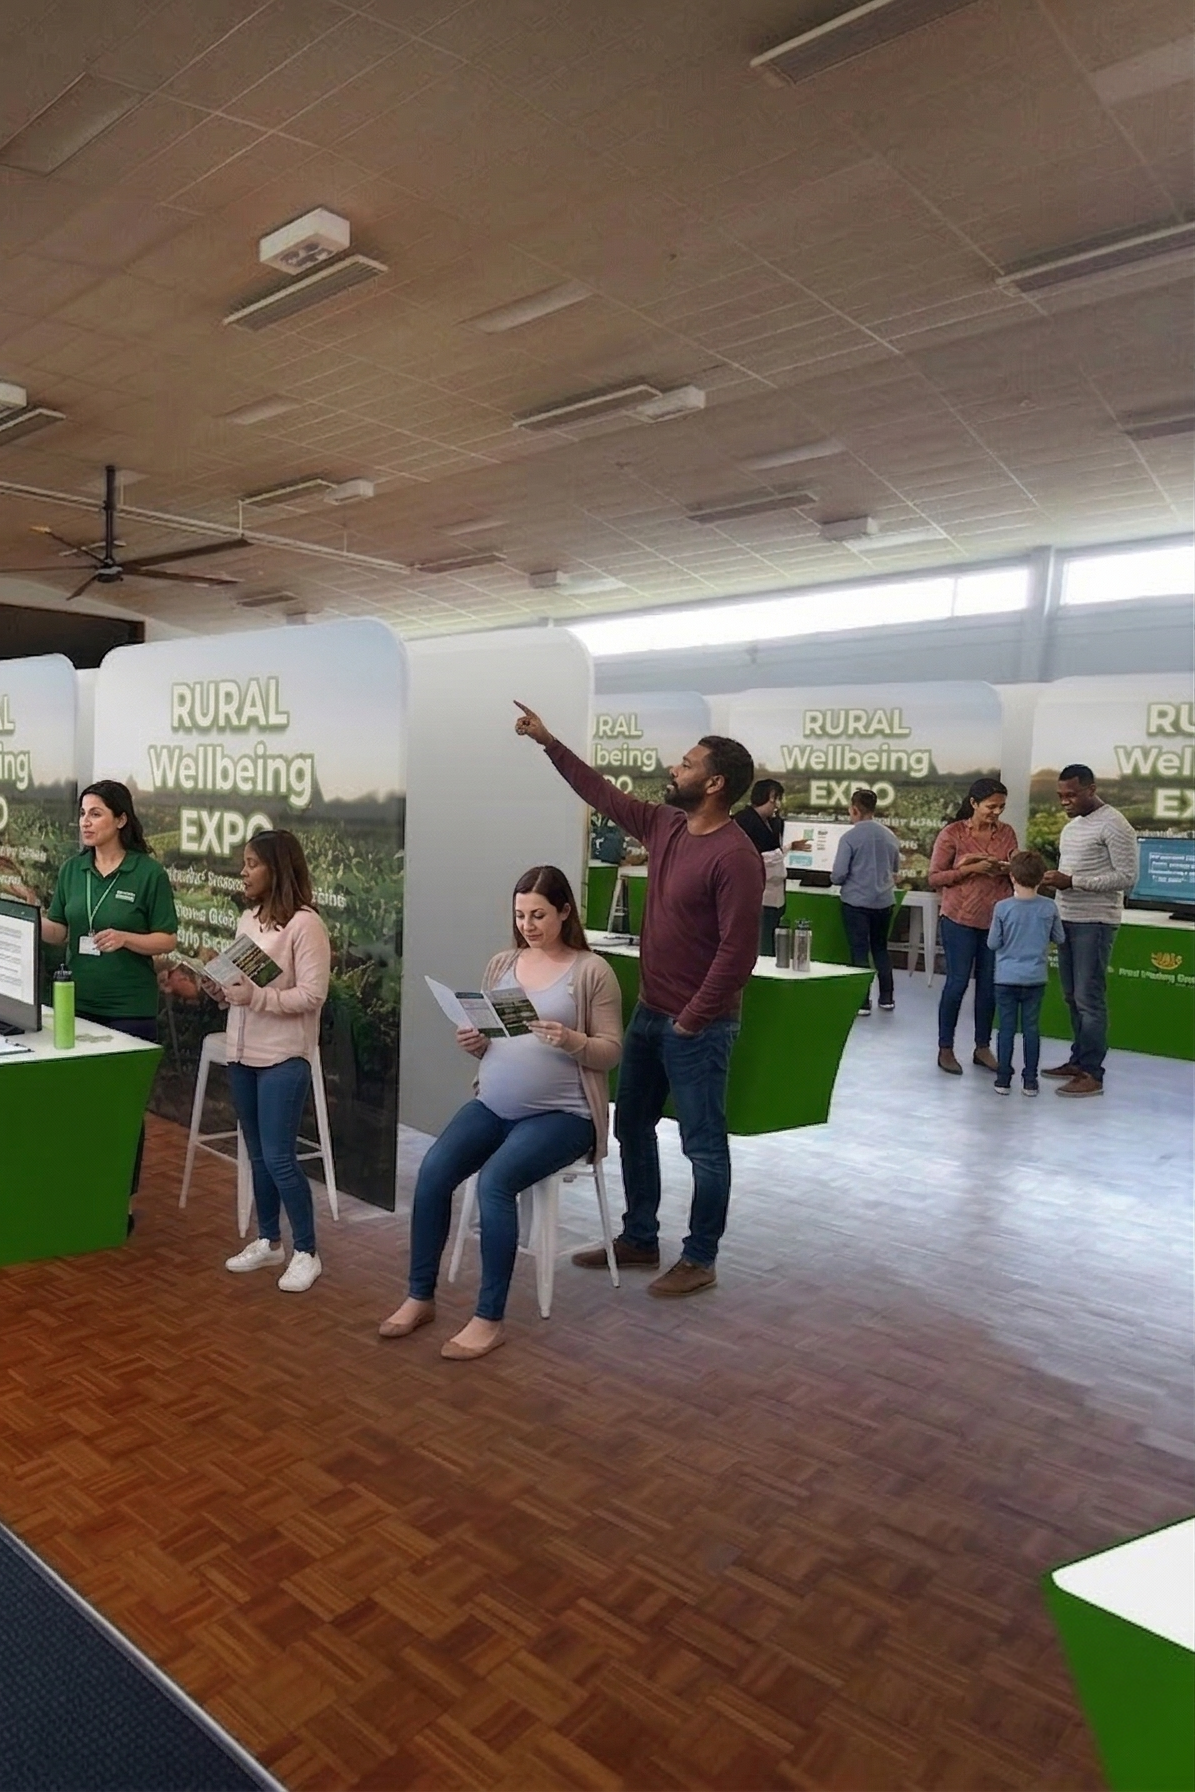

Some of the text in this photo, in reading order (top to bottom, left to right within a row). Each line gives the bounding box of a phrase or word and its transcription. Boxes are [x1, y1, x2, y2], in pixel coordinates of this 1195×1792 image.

[171, 677, 289, 731] RURAL
[593, 713, 643, 739] RAL
[803, 708, 911, 738] RURAL
[149, 742, 315, 808] Wellbeing
[781, 744, 931, 778] Wellbeing
